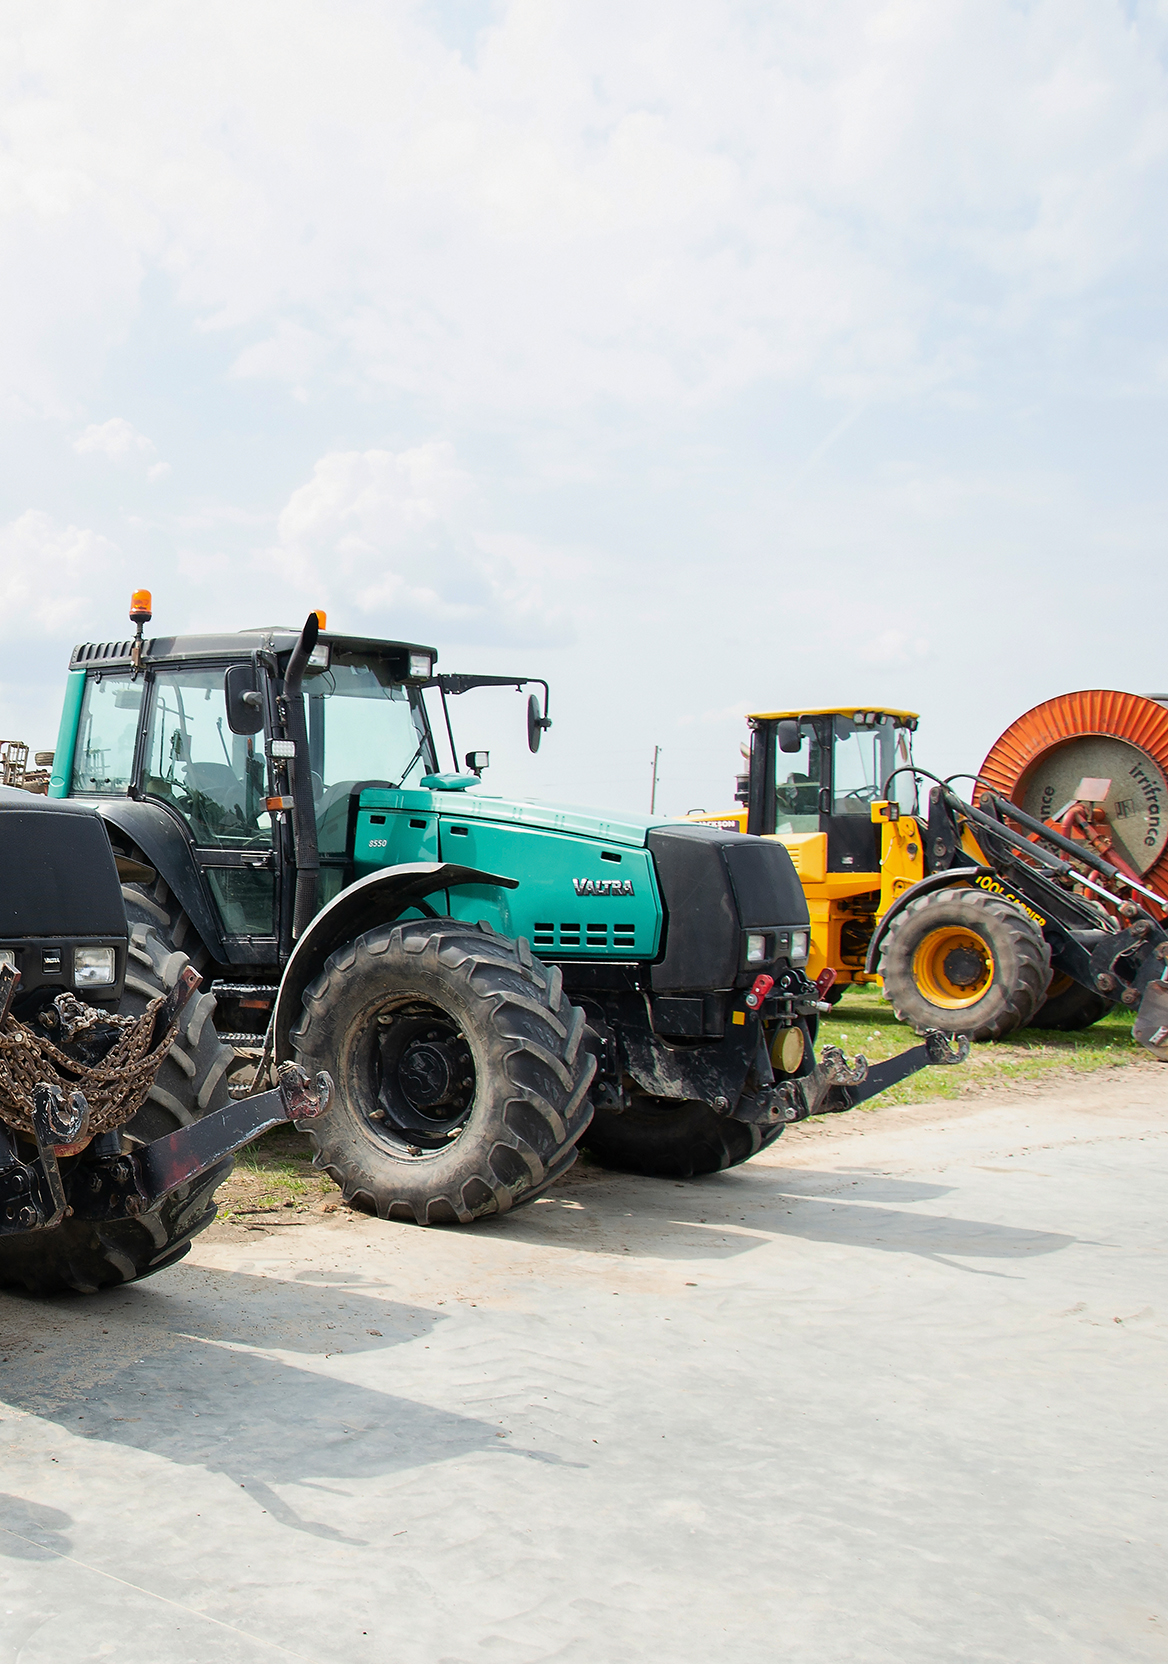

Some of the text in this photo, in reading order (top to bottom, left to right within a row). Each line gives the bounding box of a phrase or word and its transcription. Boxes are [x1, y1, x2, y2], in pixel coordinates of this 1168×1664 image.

[1128, 762, 1162, 846] irrifrance
[368, 839, 388, 848] 8550
[572, 878, 636, 897] VALTRA
